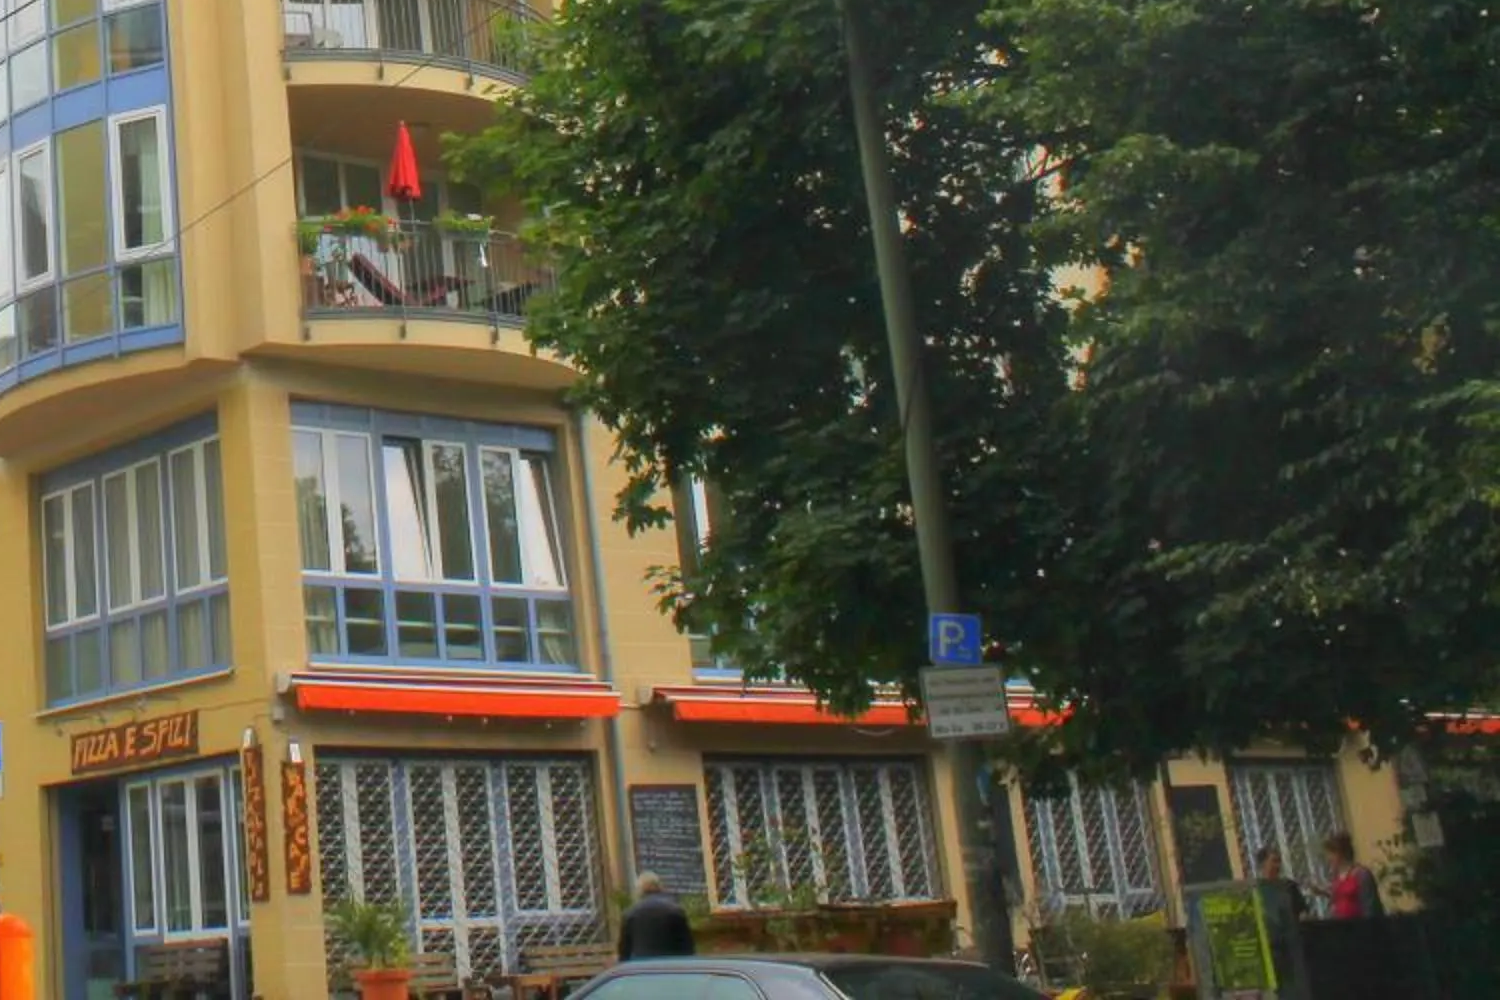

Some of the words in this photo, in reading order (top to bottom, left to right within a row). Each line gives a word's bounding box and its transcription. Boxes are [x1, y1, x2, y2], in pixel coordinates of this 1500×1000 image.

[937, 619, 965, 657] P
[73, 730, 119, 769] PIZZA
[124, 726, 137, 759] E
